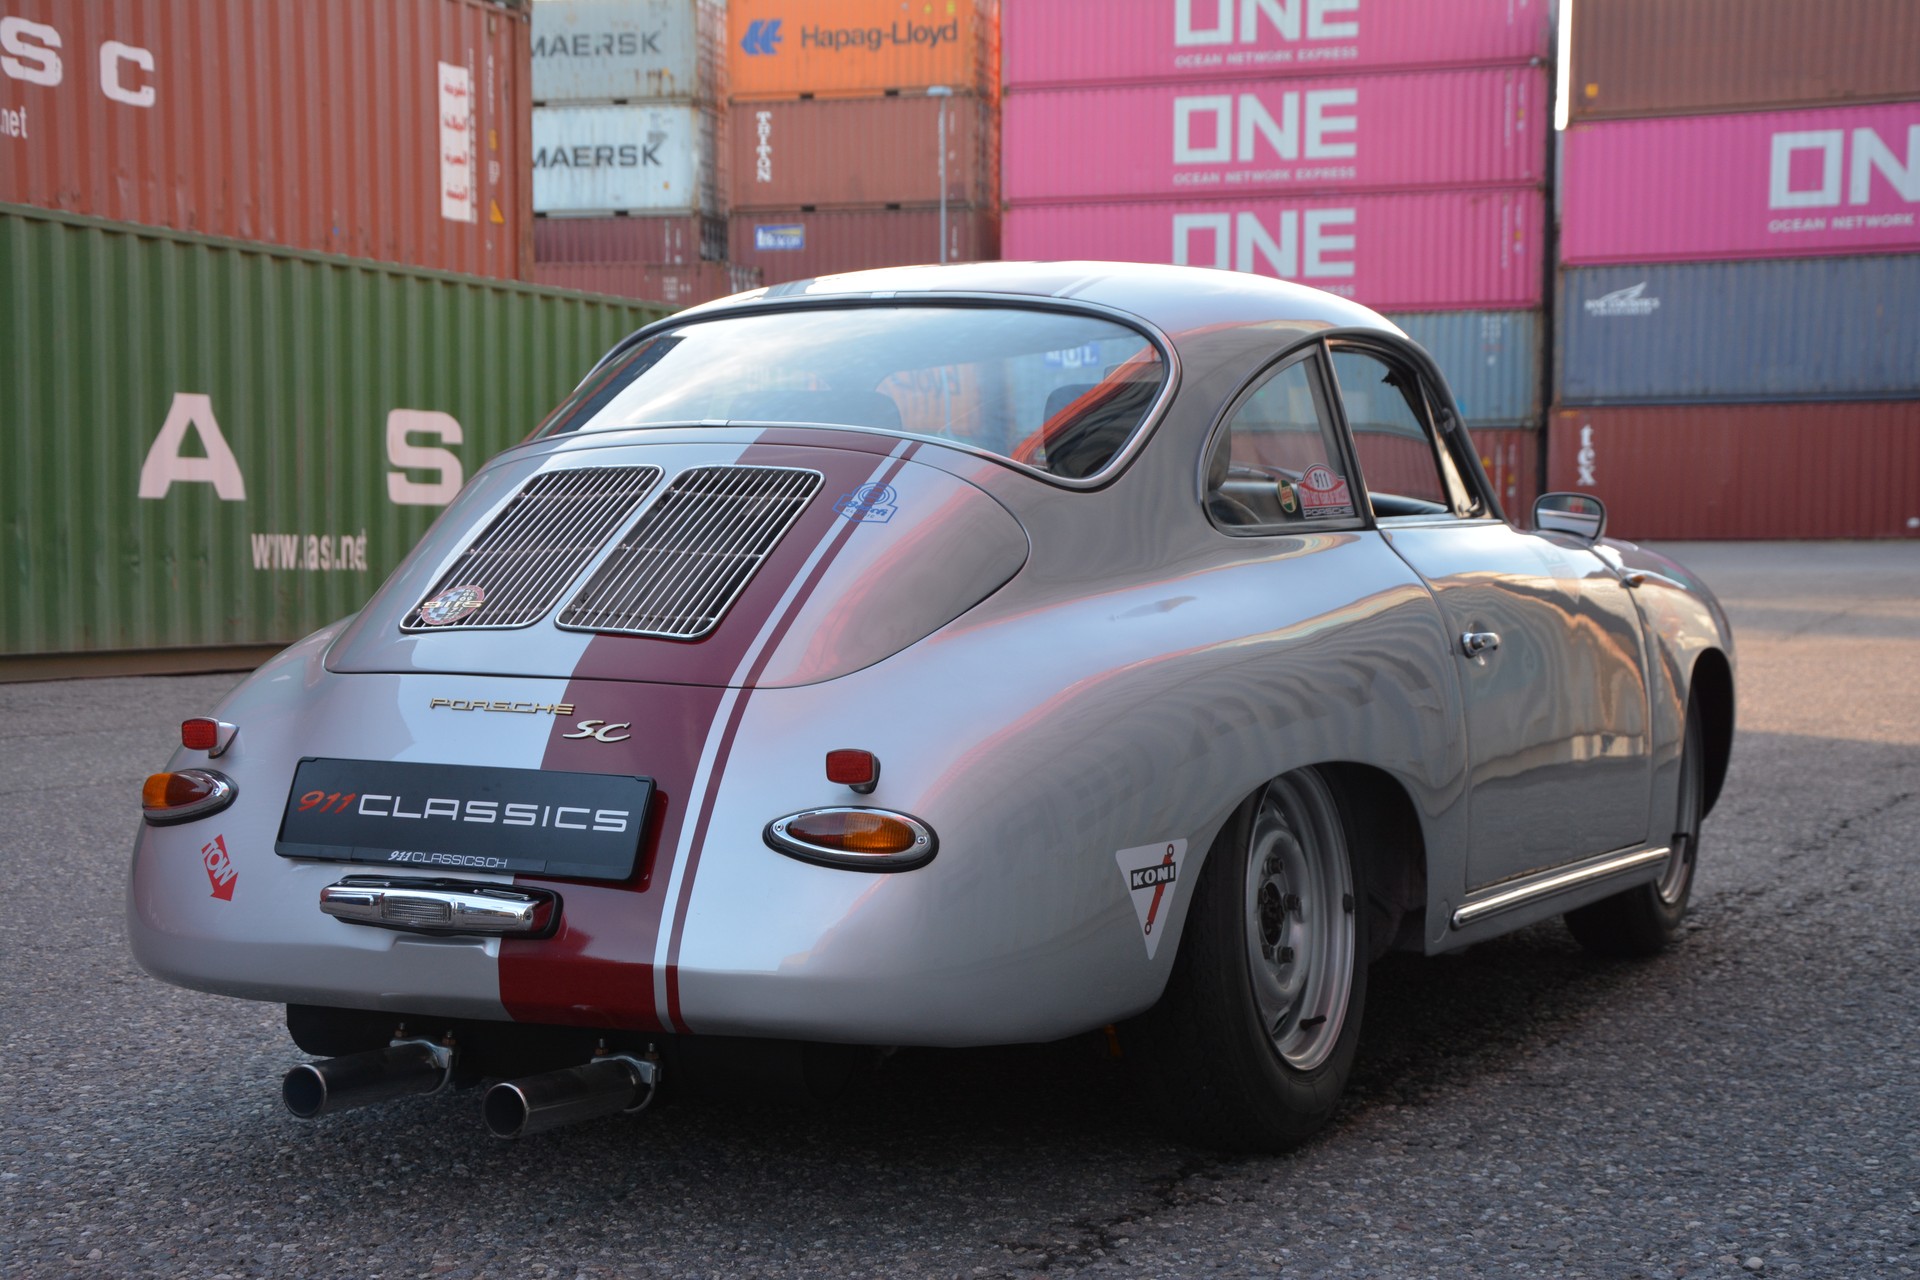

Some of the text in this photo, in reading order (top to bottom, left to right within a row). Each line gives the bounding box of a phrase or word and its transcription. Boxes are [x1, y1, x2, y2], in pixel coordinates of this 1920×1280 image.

[801, 18, 958, 51] Hapag-Lloyd
[1175, 0, 1359, 46] ONE
[1175, 46, 1358, 68] OCEAN NETWORK EXPRESS
[1173, 88, 1357, 164] ONE
[532, 143, 663, 169] MAERSK
[756, 110, 772, 183] TRITON
[1173, 166, 1356, 185] OCEAN NETWORK EXPRESS
[1768, 213, 1914, 233] OCEAN NETWORK
[1172, 208, 1356, 278] ONE
[1577, 424, 1597, 487] tex
[430, 697, 576, 716] PORSCHE
[562, 719, 631, 743] SC
[1132, 864, 1175, 888] KONI
